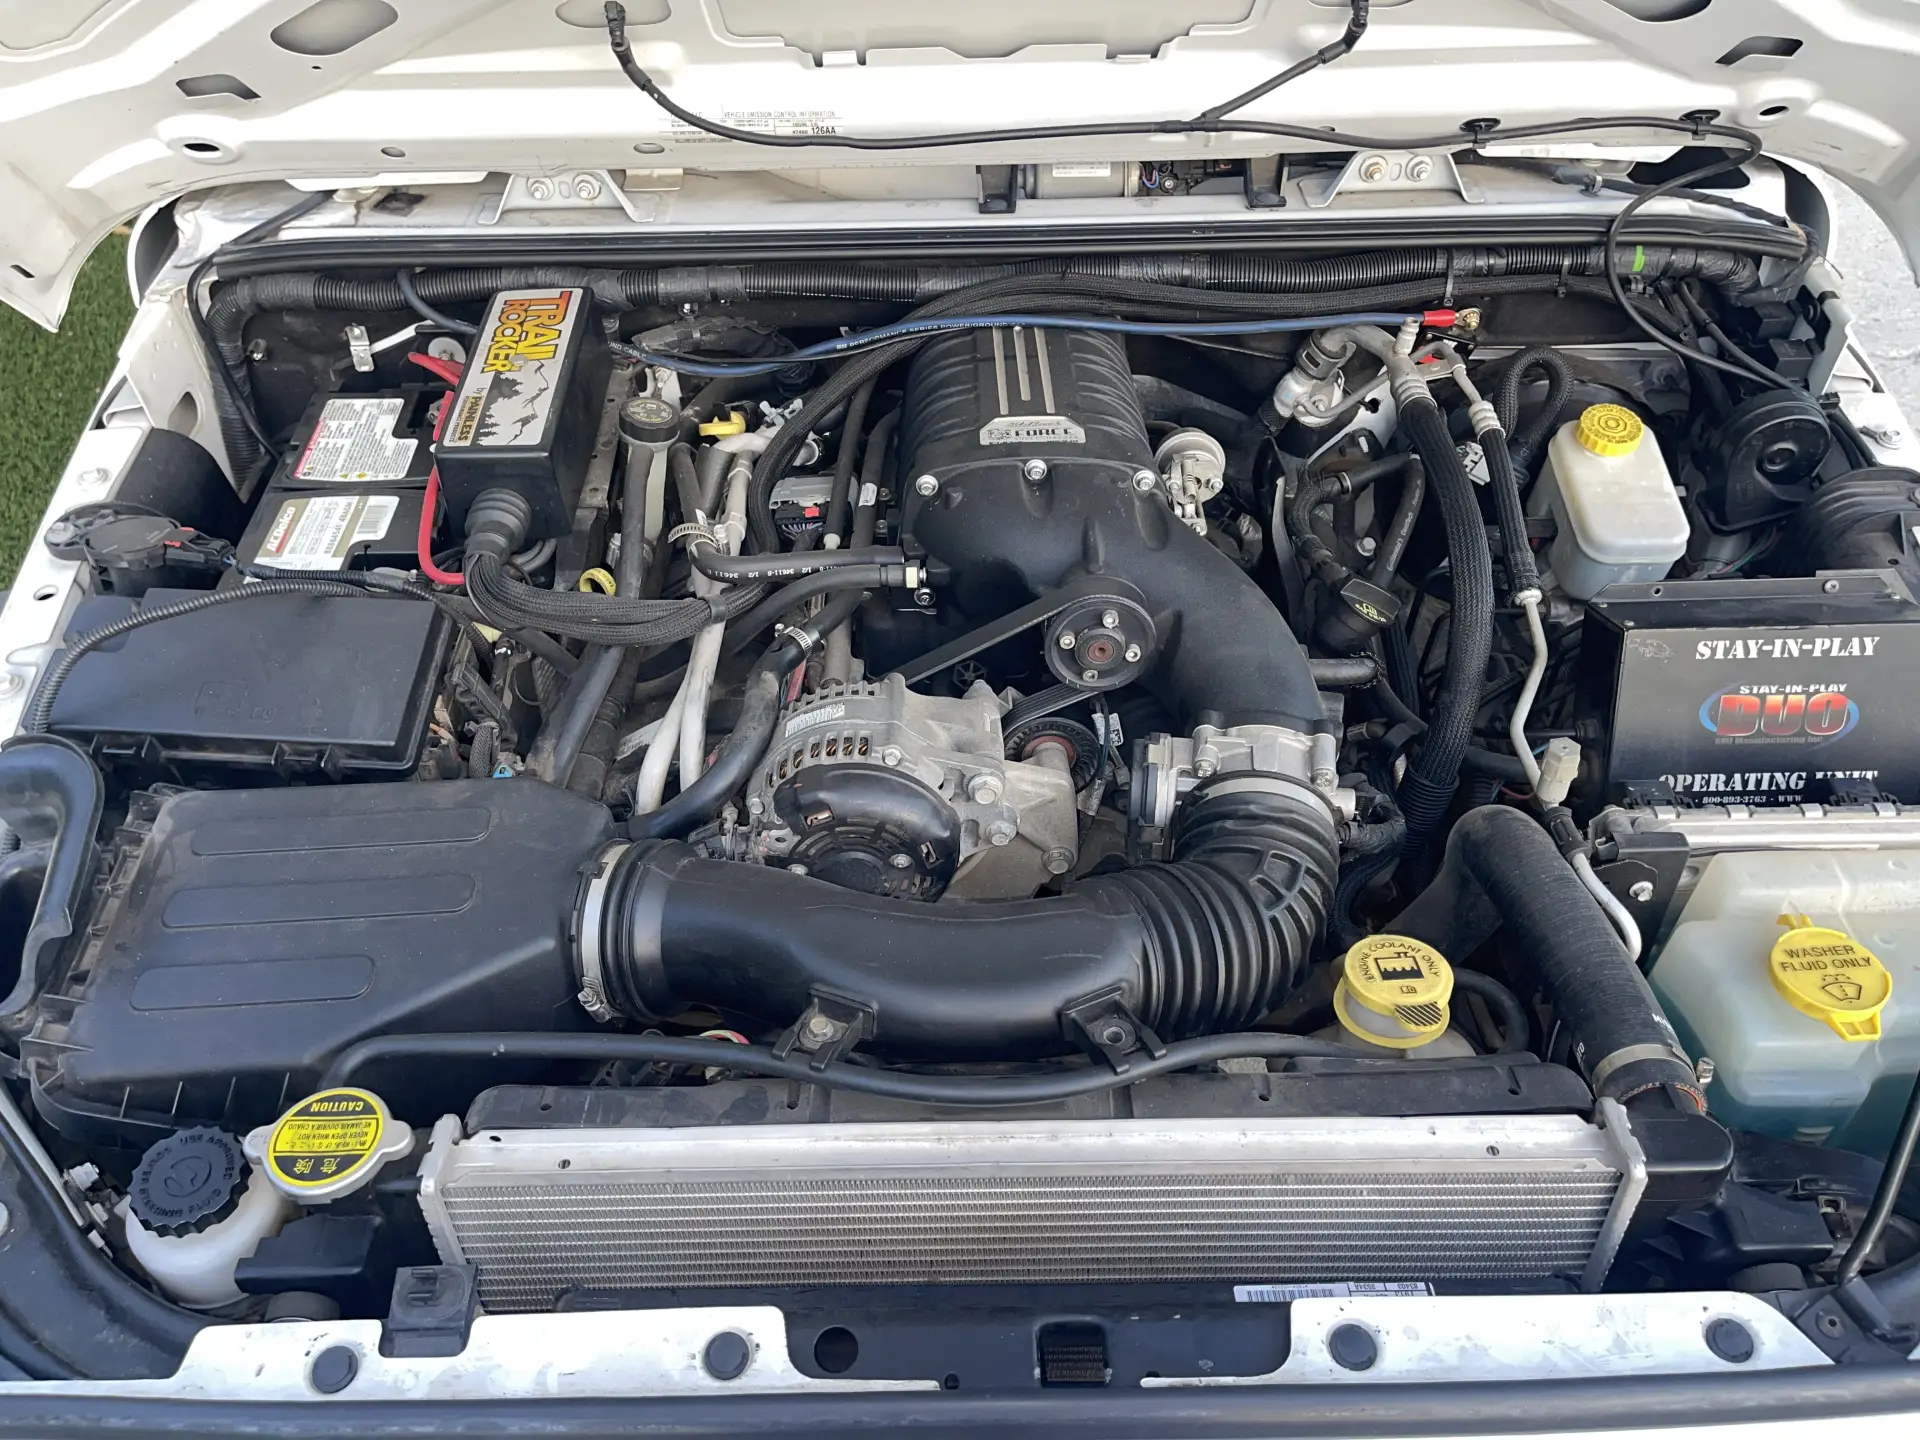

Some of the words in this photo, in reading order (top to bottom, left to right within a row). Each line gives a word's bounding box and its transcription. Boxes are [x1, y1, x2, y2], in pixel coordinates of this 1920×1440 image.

[811, 126, 837, 135] 126AA
[480, 299, 531, 374] ROCKER
[849, 329, 907, 347] PERFORMANCE
[909, 325, 939, 333] SERIES
[458, 396, 485, 442] PAINLESS
[266, 506, 297, 552] ACDelco
[1695, 636, 1880, 660] STAY-IN-PLAY
[1739, 683, 1848, 694] STAY-IN-PLAY
[1716, 692, 1850, 737] DUO
[1658, 771, 1807, 792] OPERATING
[1359, 951, 1376, 983] ENGINE
[1369, 941, 1422, 954] COOLANT
[1422, 954, 1440, 977] ONLY
[1784, 945, 1856, 959] WASHER
[1780, 959, 1828, 972] FLUID
[1832, 957, 1872, 969] ONLY
[310, 1101, 365, 1112] CAUTION
[331, 1132, 348, 1140] OPEN
[347, 1131, 369, 1140] NEVER
